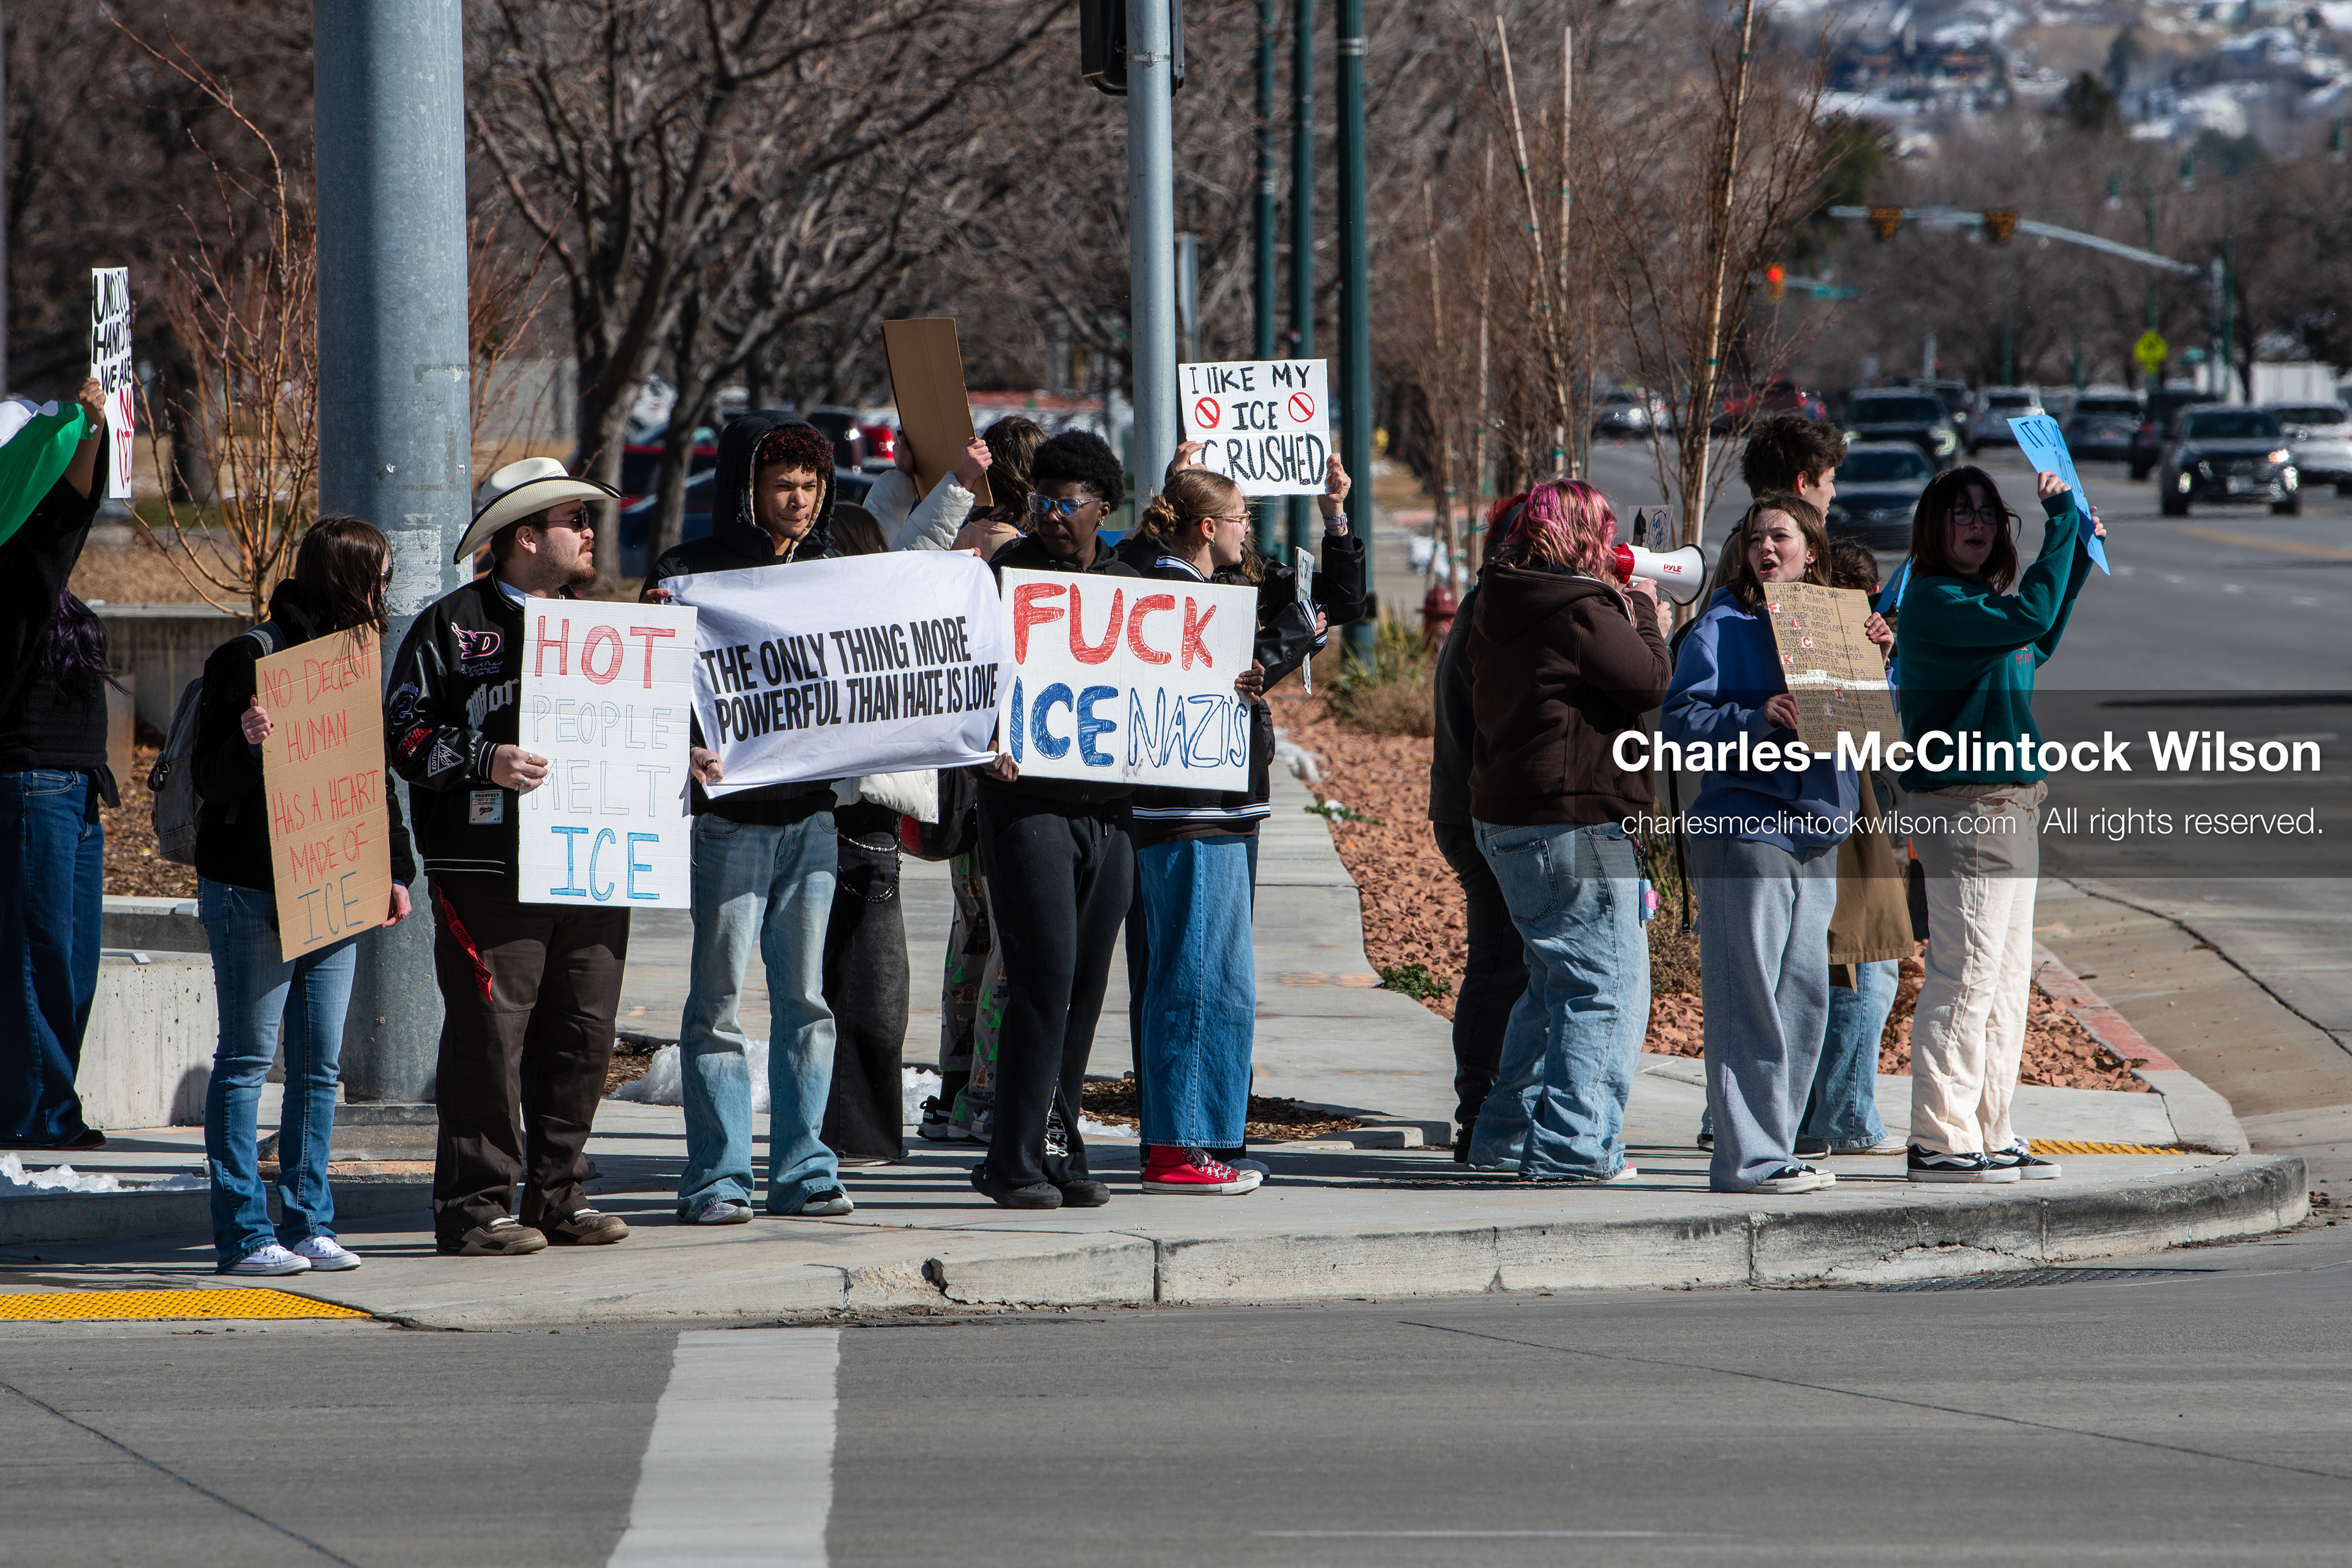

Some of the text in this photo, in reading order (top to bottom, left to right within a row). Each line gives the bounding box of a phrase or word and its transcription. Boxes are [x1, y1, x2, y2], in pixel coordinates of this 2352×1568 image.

[100, 355, 132, 396] WE ARE
[1189, 367, 1199, 394] I
[1272, 363, 1310, 388] MY
[1231, 400, 1278, 431] ICE
[2018, 421, 2044, 448] IT
[2034, 420, 2056, 447] IS
[1200, 432, 1325, 485] CRUSHED
[1802, 585, 1825, 596] MOLINA
[1805, 595, 1827, 605] ALANIS
[1013, 582, 1216, 671] FUCK
[1776, 619, 1808, 629] MANUEL
[1811, 621, 1829, 631] MATEO
[1779, 629, 1828, 639] RENEE GOOD
[1812, 614, 1830, 623] DAVIS
[535, 616, 676, 689] HOT
[699, 616, 971, 695] THE ONLY THING MORE
[1781, 638, 1801, 647] JOSE
[1783, 654, 1840, 666] KEITH PORTER
[1809, 647, 1836, 657] SANCHEZ
[263, 643, 373, 713] NO DECENT
[1790, 670, 1824, 679] ENRIQUE
[1793, 680, 1817, 688] ELENA
[714, 663, 998, 744] POWERFUL THAN HATE IS LOVE
[1010, 676, 1118, 767] ICE
[1801, 714, 1825, 725] YAHIR
[1827, 714, 1844, 724] DAVID
[285, 708, 348, 765] HUMAN
[532, 695, 672, 749] PEOPLE
[271, 770, 379, 842] HAS A HEART
[531, 758, 671, 818] MELT
[290, 821, 369, 884] MADE OF
[550, 826, 660, 902] ICE
[297, 871, 365, 945] ICE
[452, 923, 473, 946] HIGH
